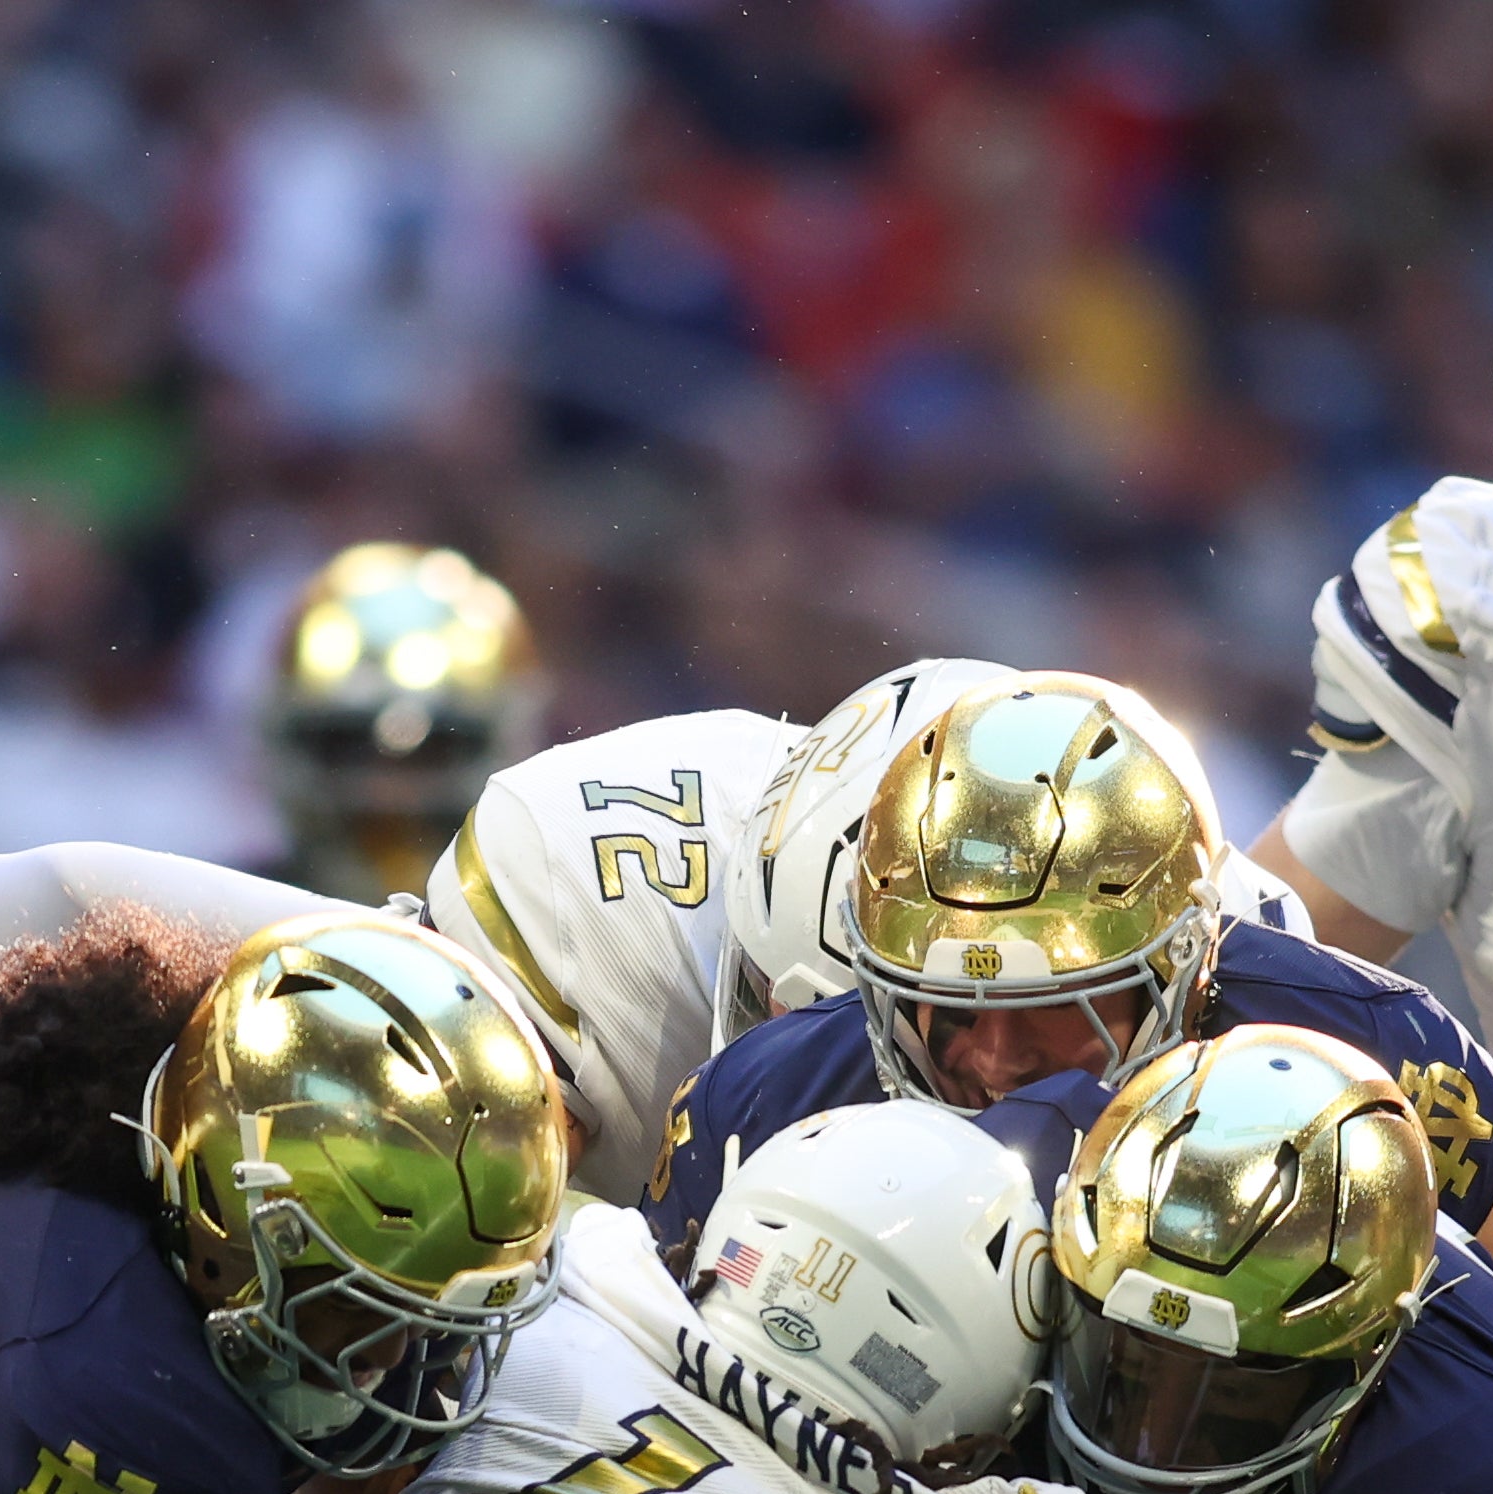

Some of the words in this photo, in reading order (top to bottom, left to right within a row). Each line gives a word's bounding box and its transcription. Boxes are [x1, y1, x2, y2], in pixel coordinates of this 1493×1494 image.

[579, 768, 709, 910] 72
[794, 1237, 858, 1304] 11
[770, 1312, 816, 1345] ACC
